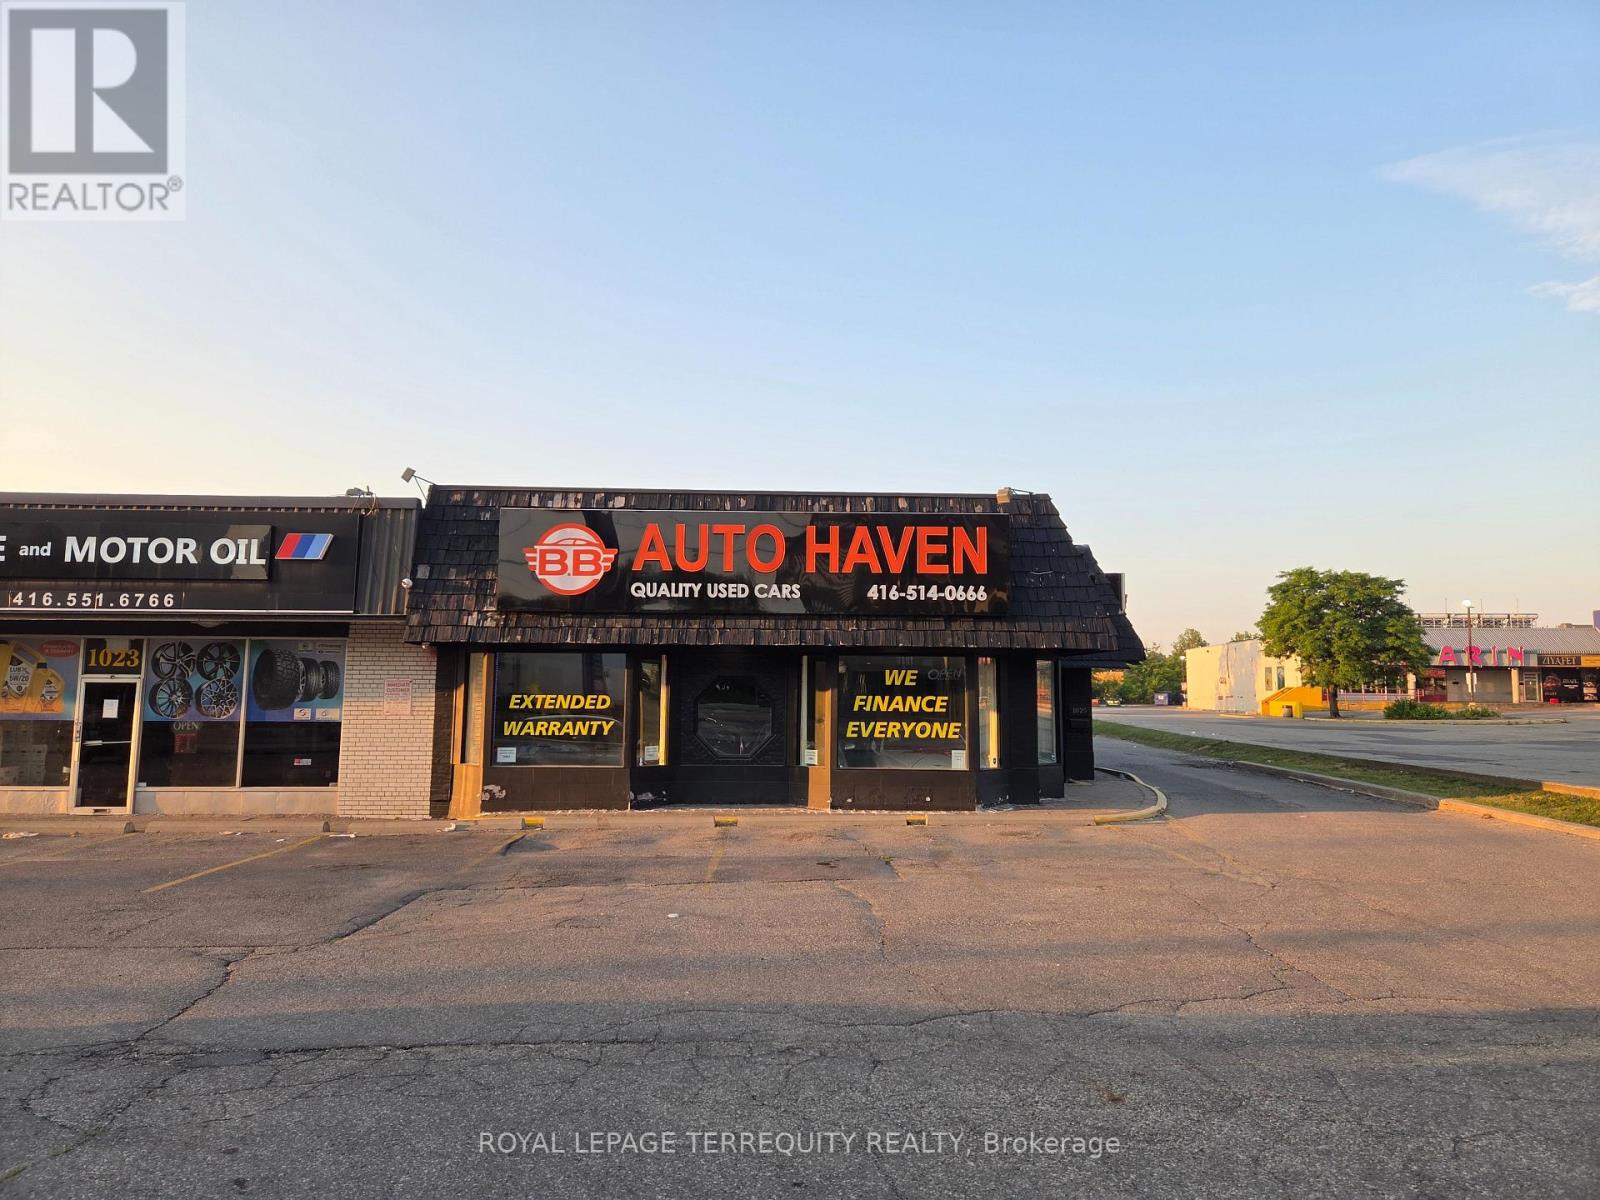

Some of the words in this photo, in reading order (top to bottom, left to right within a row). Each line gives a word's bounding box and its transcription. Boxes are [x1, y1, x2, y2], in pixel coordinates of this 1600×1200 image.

[19, 541, 52, 557] and
[64, 536, 198, 564] MOTOR
[209, 537, 267, 565] OIL
[631, 523, 786, 573] AUTO
[805, 525, 988, 575] HAVEN
[630, 582, 702, 598] QUALITY
[706, 583, 750, 599] USED
[754, 583, 801, 599] CARS
[866, 584, 988, 601] 416-514-0666
[12, 592, 175, 608] 416.551.6766
[87, 648, 139, 668] 1023
[1542, 656, 1577, 665] ZIYAFET
[884, 669, 919, 686] WE
[927, 669, 962, 681] OPEN
[508, 694, 611, 710] EXTENDED
[853, 695, 949, 712] FINANCE
[173, 720, 199, 731] OPEN
[503, 720, 615, 736] WARRANTY
[846, 721, 962, 739] EVERYONE
